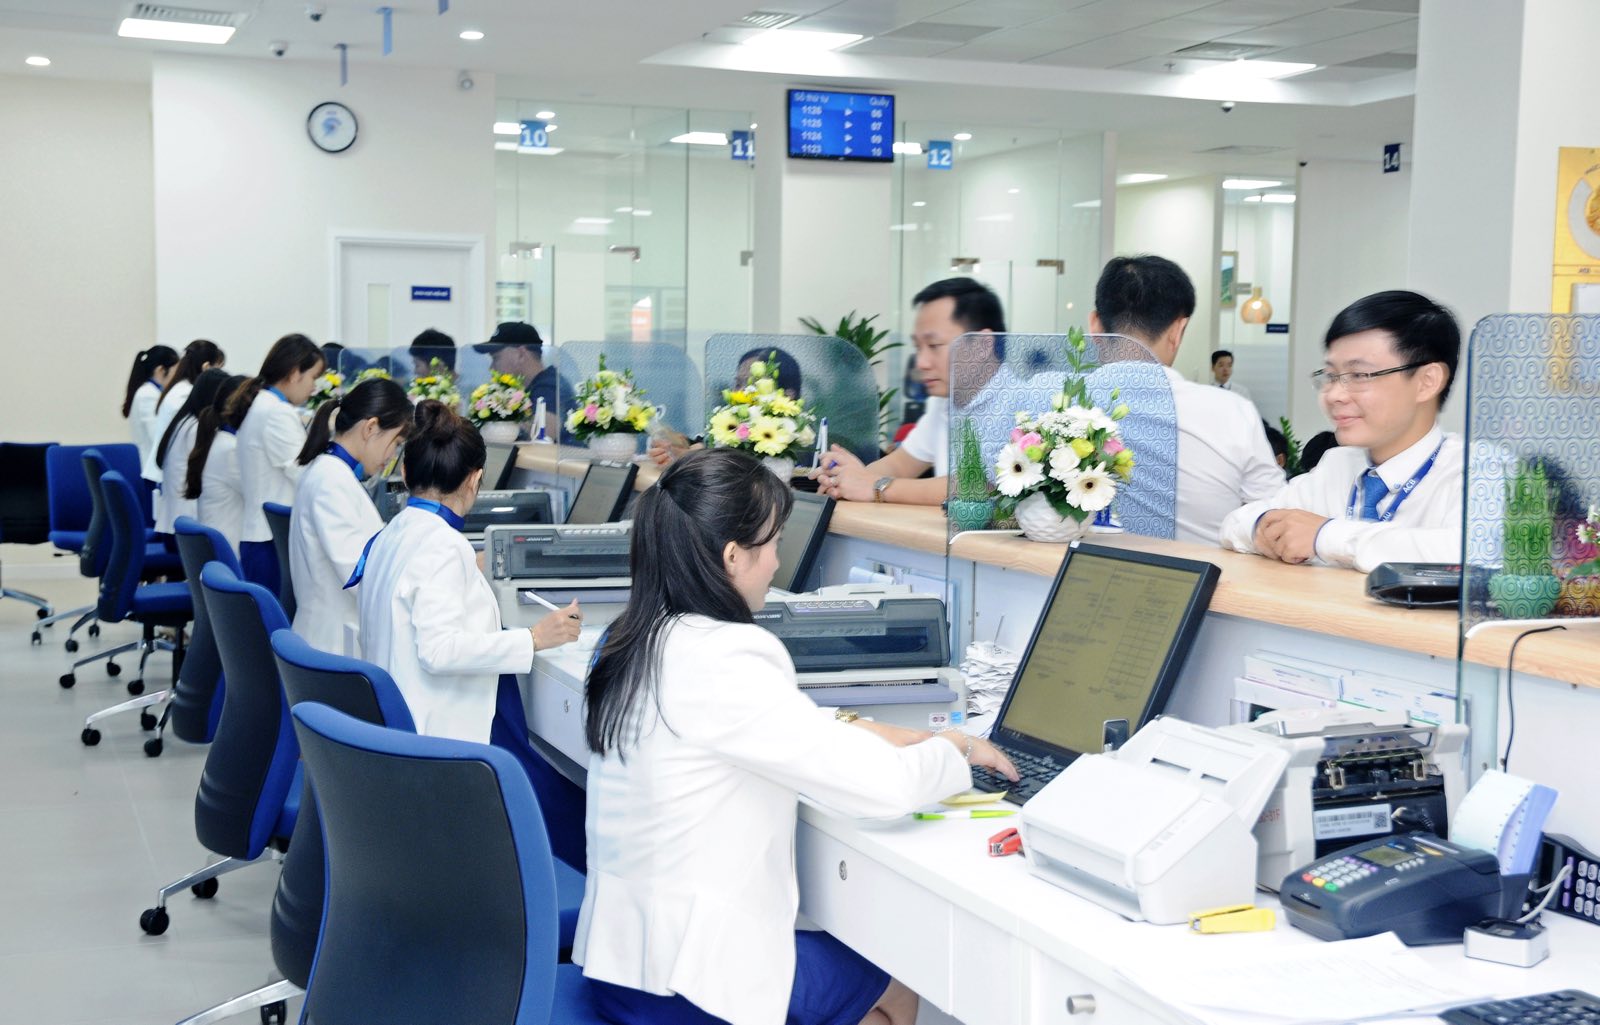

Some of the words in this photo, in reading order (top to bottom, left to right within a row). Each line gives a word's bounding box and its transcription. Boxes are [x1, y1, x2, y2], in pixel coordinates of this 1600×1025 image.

[522, 129, 547, 147] 10
[733, 139, 755, 157] 11
[930, 149, 952, 166] 12
[1384, 151, 1399, 169] 14
[1402, 478, 1416, 494] ACB
